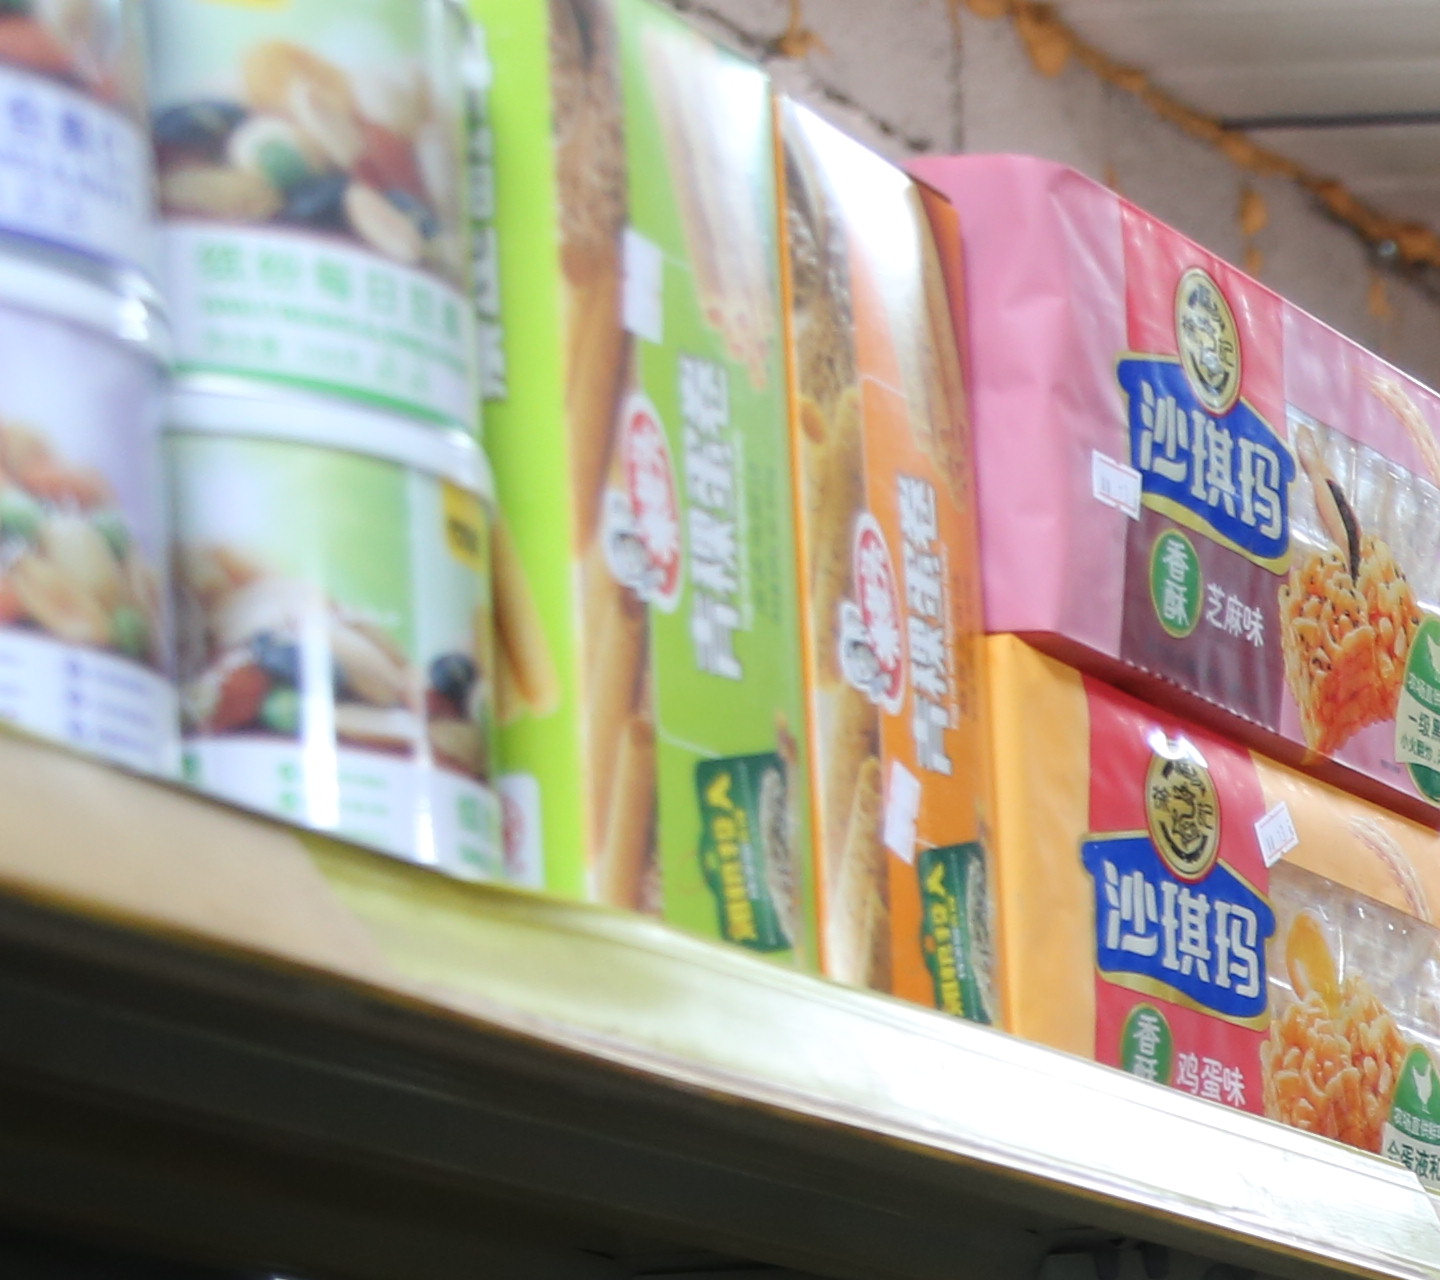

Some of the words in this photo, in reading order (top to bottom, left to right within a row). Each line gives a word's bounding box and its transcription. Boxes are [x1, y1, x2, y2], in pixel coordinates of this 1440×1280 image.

[1139, 380, 1281, 541] 沙琪玛
[1161, 540, 1191, 627] 香酥
[1205, 582, 1266, 648] 芝麻味
[1104, 860, 1261, 999] 沙琪玛
[1177, 1051, 1247, 1107] 鸡蛋味
